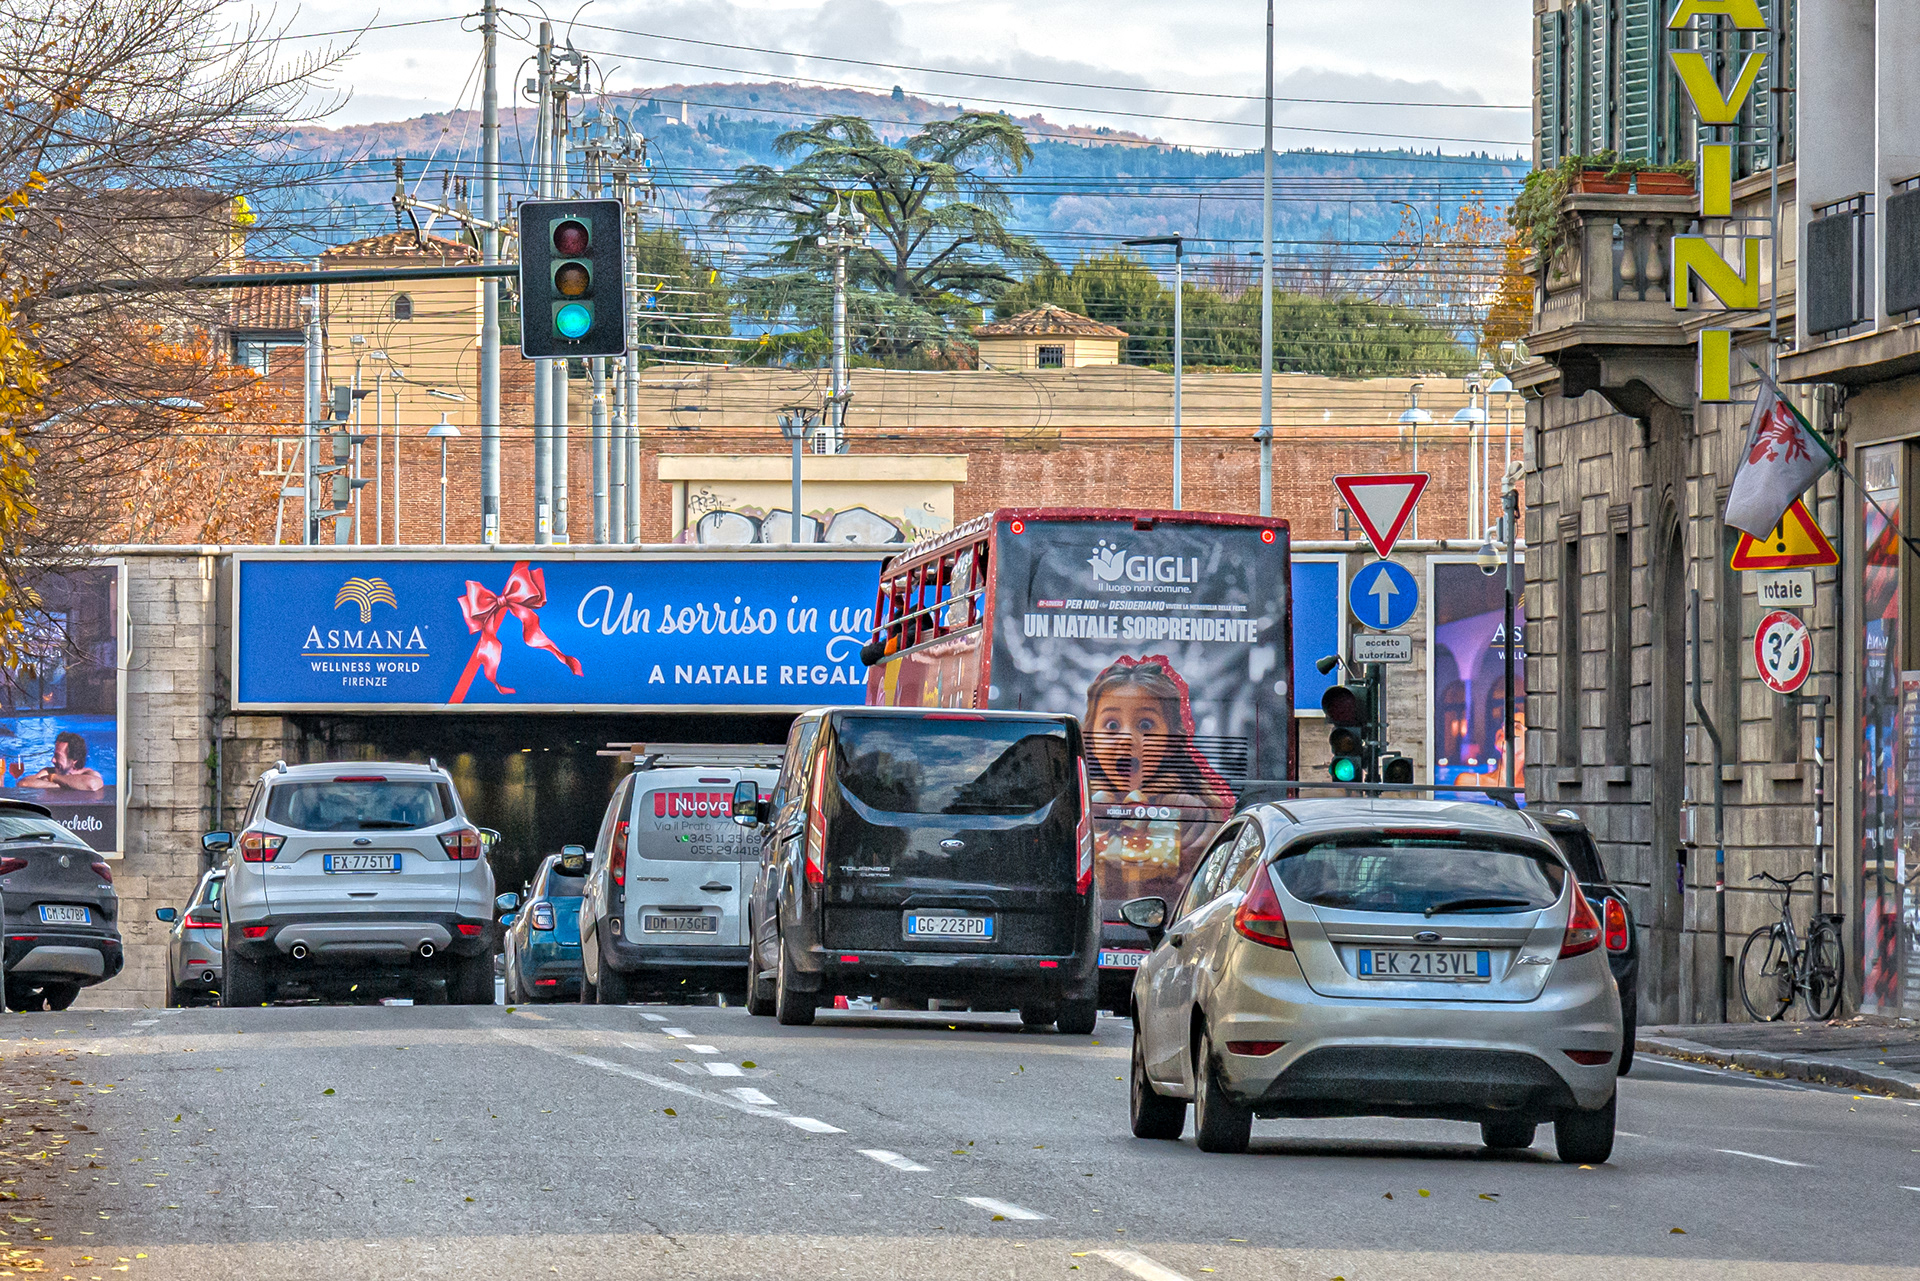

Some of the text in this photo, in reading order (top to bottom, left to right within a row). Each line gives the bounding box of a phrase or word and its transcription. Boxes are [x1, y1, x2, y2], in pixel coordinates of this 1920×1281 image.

[1105, 583, 1132, 593] luogo
[1133, 584, 1152, 592] non
[1153, 585, 1192, 593] comune.
[1763, 580, 1803, 598] rotaie
[577, 585, 650, 635] Un
[656, 596, 777, 635] sorriso
[787, 595, 817, 635] in
[829, 607, 873, 633] un
[1065, 599, 1082, 610] PER
[1083, 599, 1099, 610] NOI
[1108, 600, 1166, 611] DESIDERIAMO
[1023, 614, 1258, 643] UN NATALE SORPRENDENTE
[302, 625, 428, 650] ASMANA
[1365, 639, 1400, 647] eccetto
[1358, 651, 1408, 660] autorizzati
[310, 662, 420, 673] WELLNESS WORLD
[648, 664, 666, 684] A
[674, 665, 768, 685] NATALE
[342, 677, 388, 687] FIRENZE
[675, 797, 729, 812] Nuova
[654, 822, 671, 831] Via
[673, 822, 679, 831] il
[690, 833, 713, 844] 345
[716, 834, 725, 843] 11
[727, 834, 743, 844] 35
[690, 845, 760, 856] 055 294418
[333, 855, 394, 869] FX 775TY
[46, 907, 58, 920] GM
[653, 917, 709, 930] DM 173GF
[918, 918, 935, 931] GG
[940, 918, 984, 933] 223PD
[1105, 954, 1119, 965] FX
[1375, 953, 1400, 974] EK
[1409, 953, 1475, 974] 213VL
